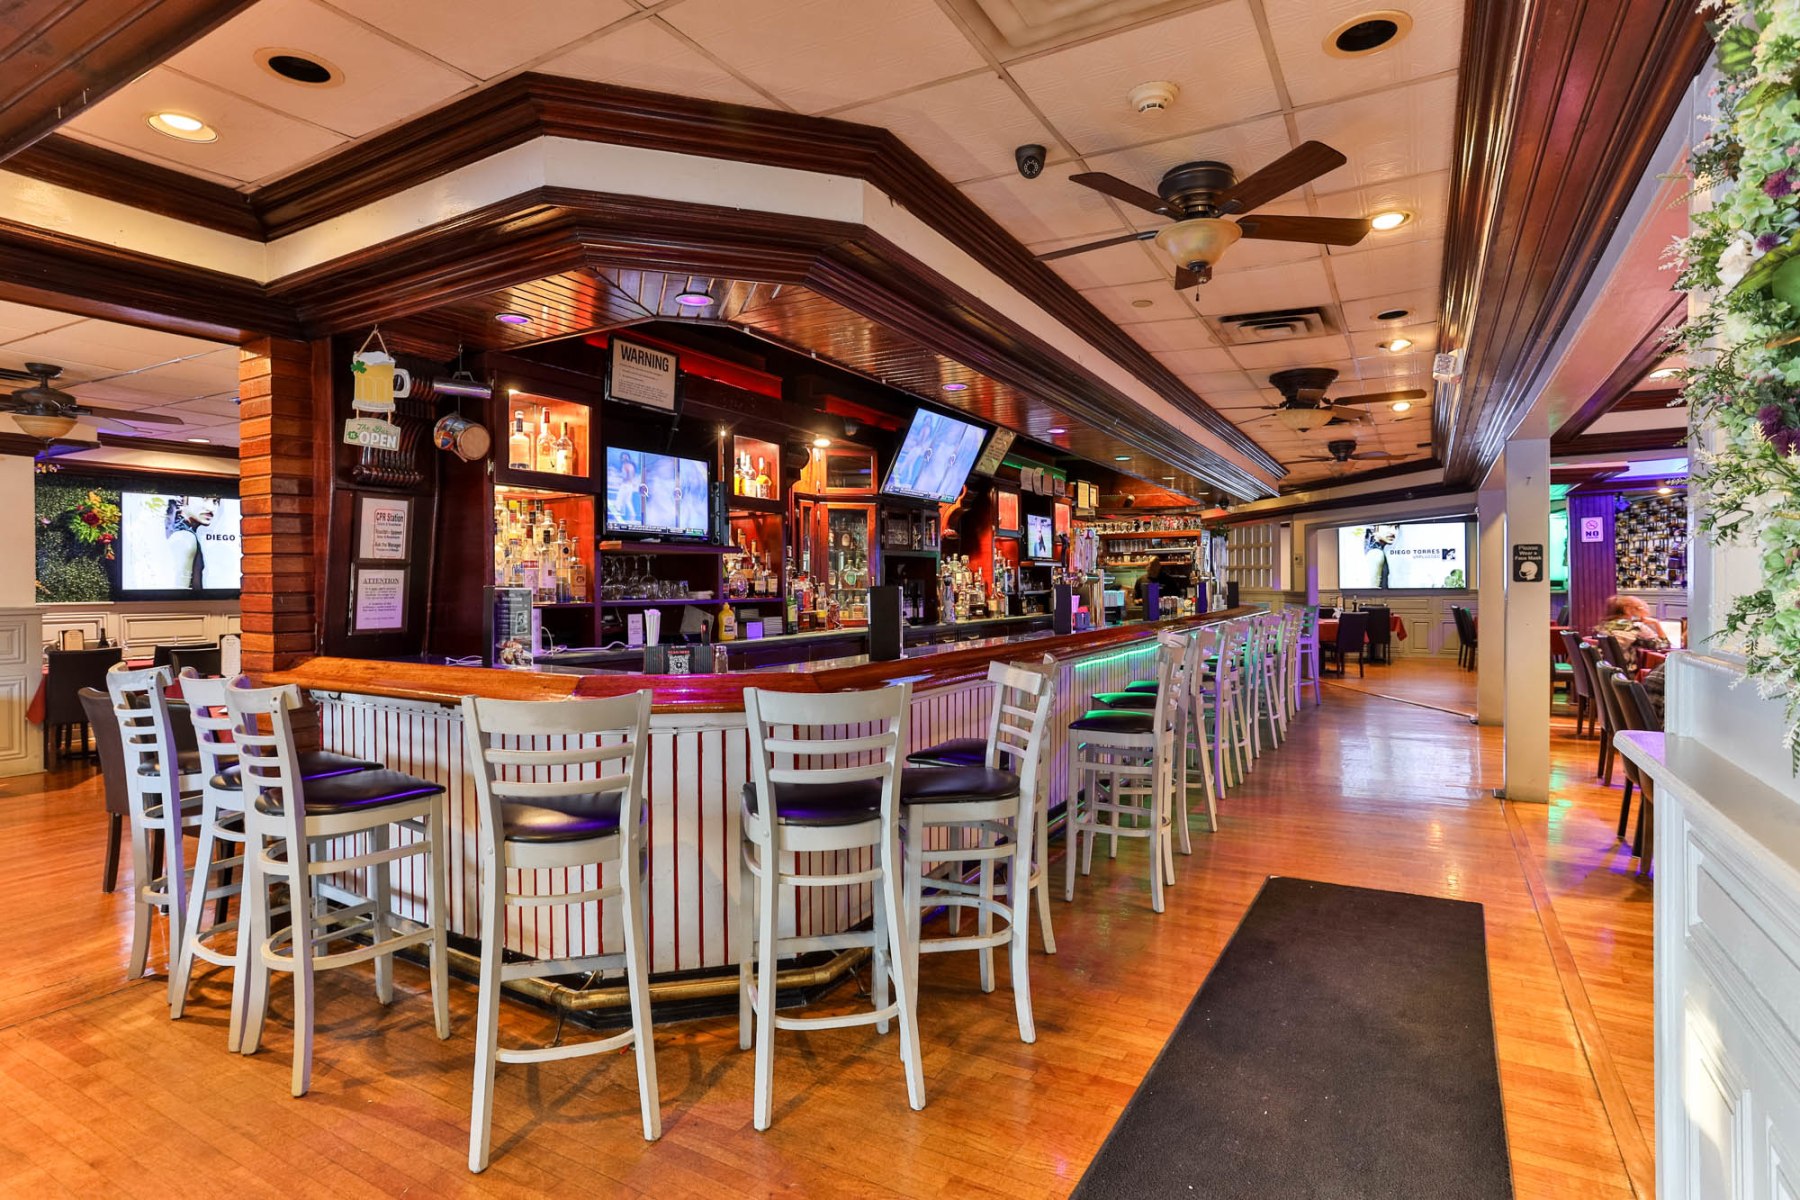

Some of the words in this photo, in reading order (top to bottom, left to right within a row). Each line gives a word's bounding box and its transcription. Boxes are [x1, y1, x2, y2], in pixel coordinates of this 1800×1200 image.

[620, 344, 669, 373] WARNING
[360, 431, 397, 449] OPEN
[376, 512, 386, 521] CPR
[387, 513, 404, 522] Station
[362, 577, 400, 585] ATTENTION
